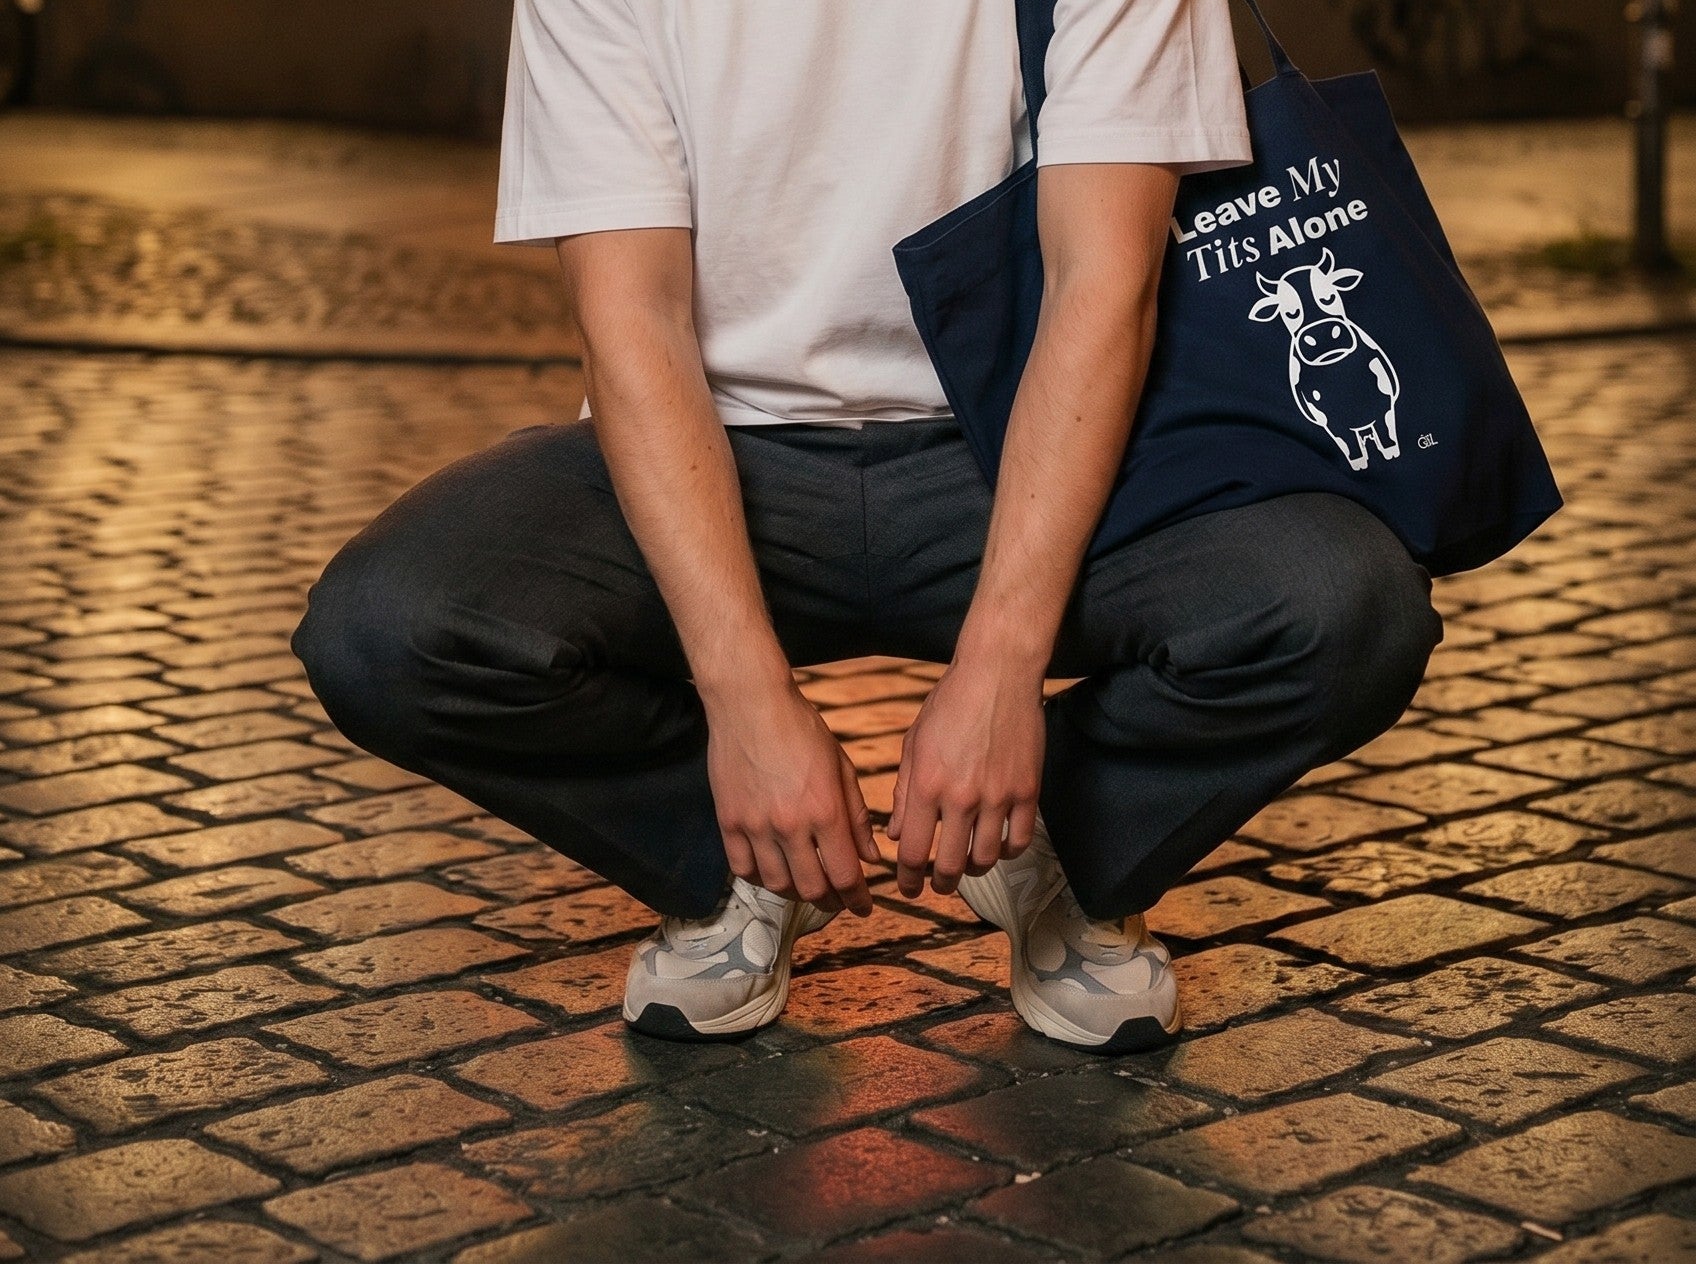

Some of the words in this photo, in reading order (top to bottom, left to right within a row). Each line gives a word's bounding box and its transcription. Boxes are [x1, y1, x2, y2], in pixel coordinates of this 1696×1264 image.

[1170, 185, 1282, 244] Leave
[1286, 156, 1340, 202] My
[1186, 236, 1261, 282] Tits
[1269, 199, 1369, 256] Alone
